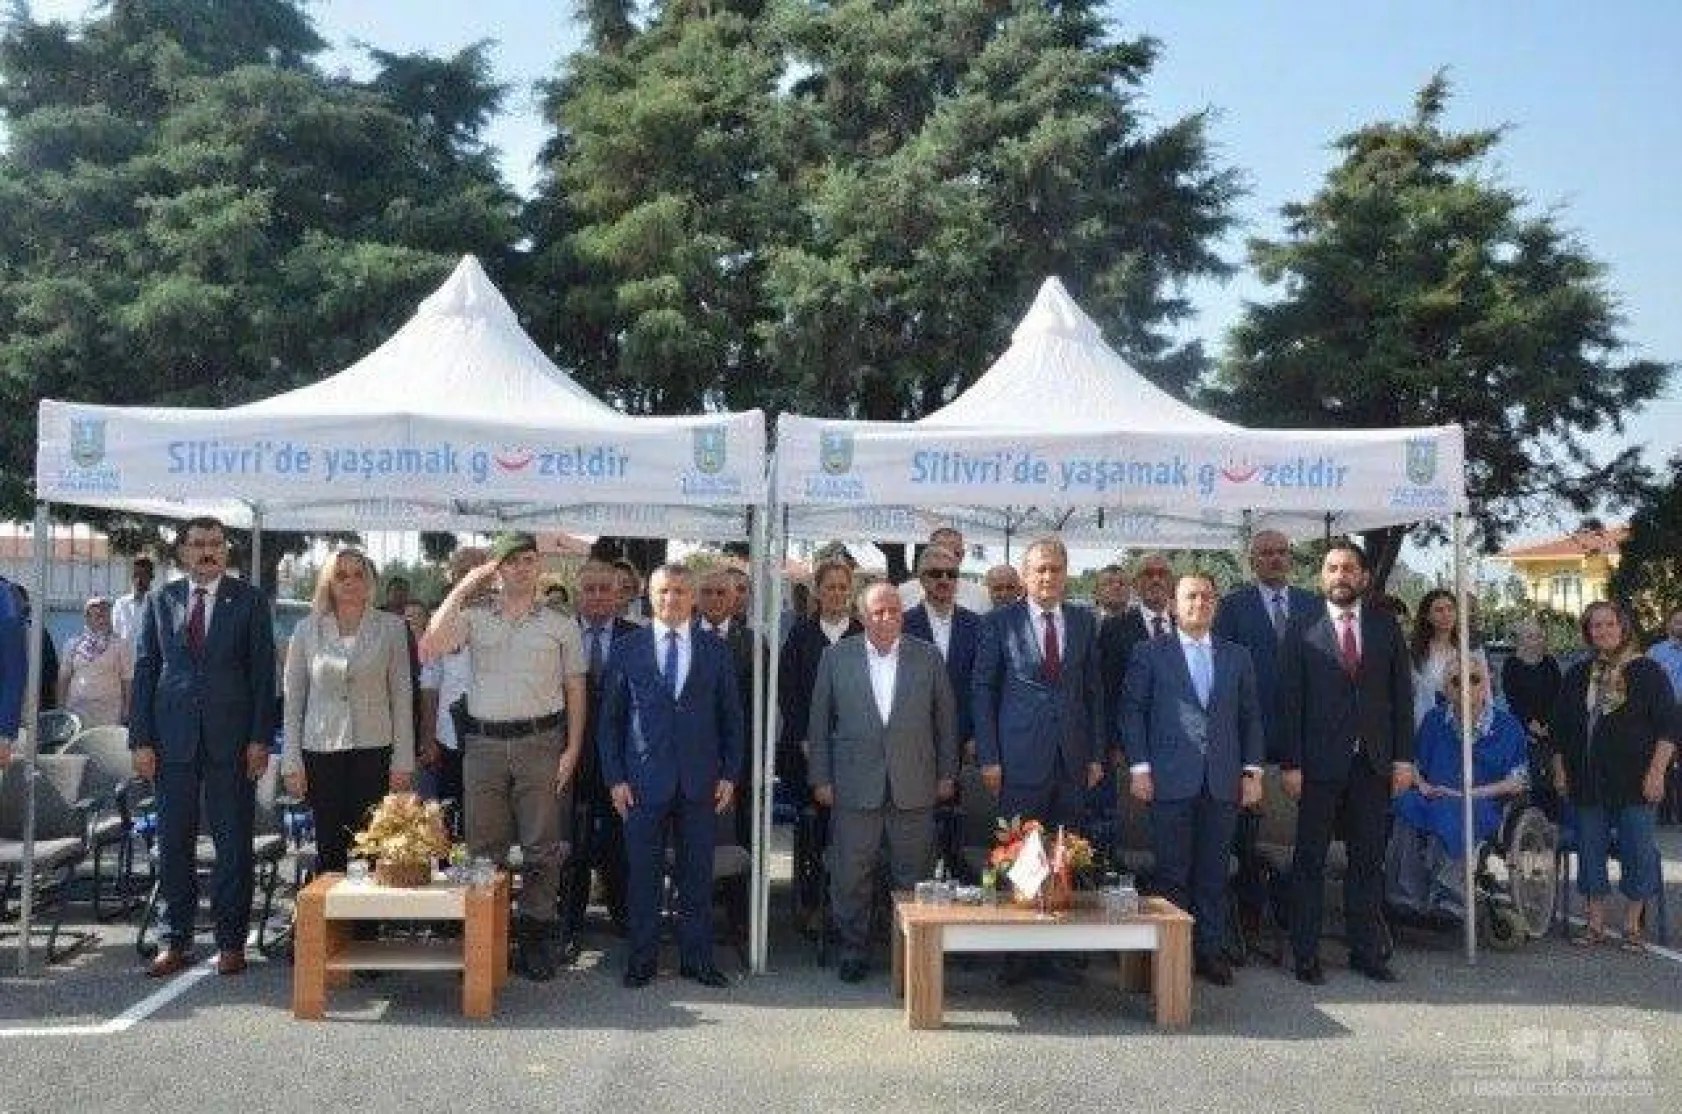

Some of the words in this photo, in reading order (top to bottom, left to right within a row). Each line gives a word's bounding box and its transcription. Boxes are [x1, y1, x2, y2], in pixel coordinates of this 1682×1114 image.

[167, 441, 311, 474] Silivri'de
[324, 444, 458, 482] yaşamak
[911, 449, 1048, 485] Silivri'de
[1060, 457, 1188, 491] yaşamak
